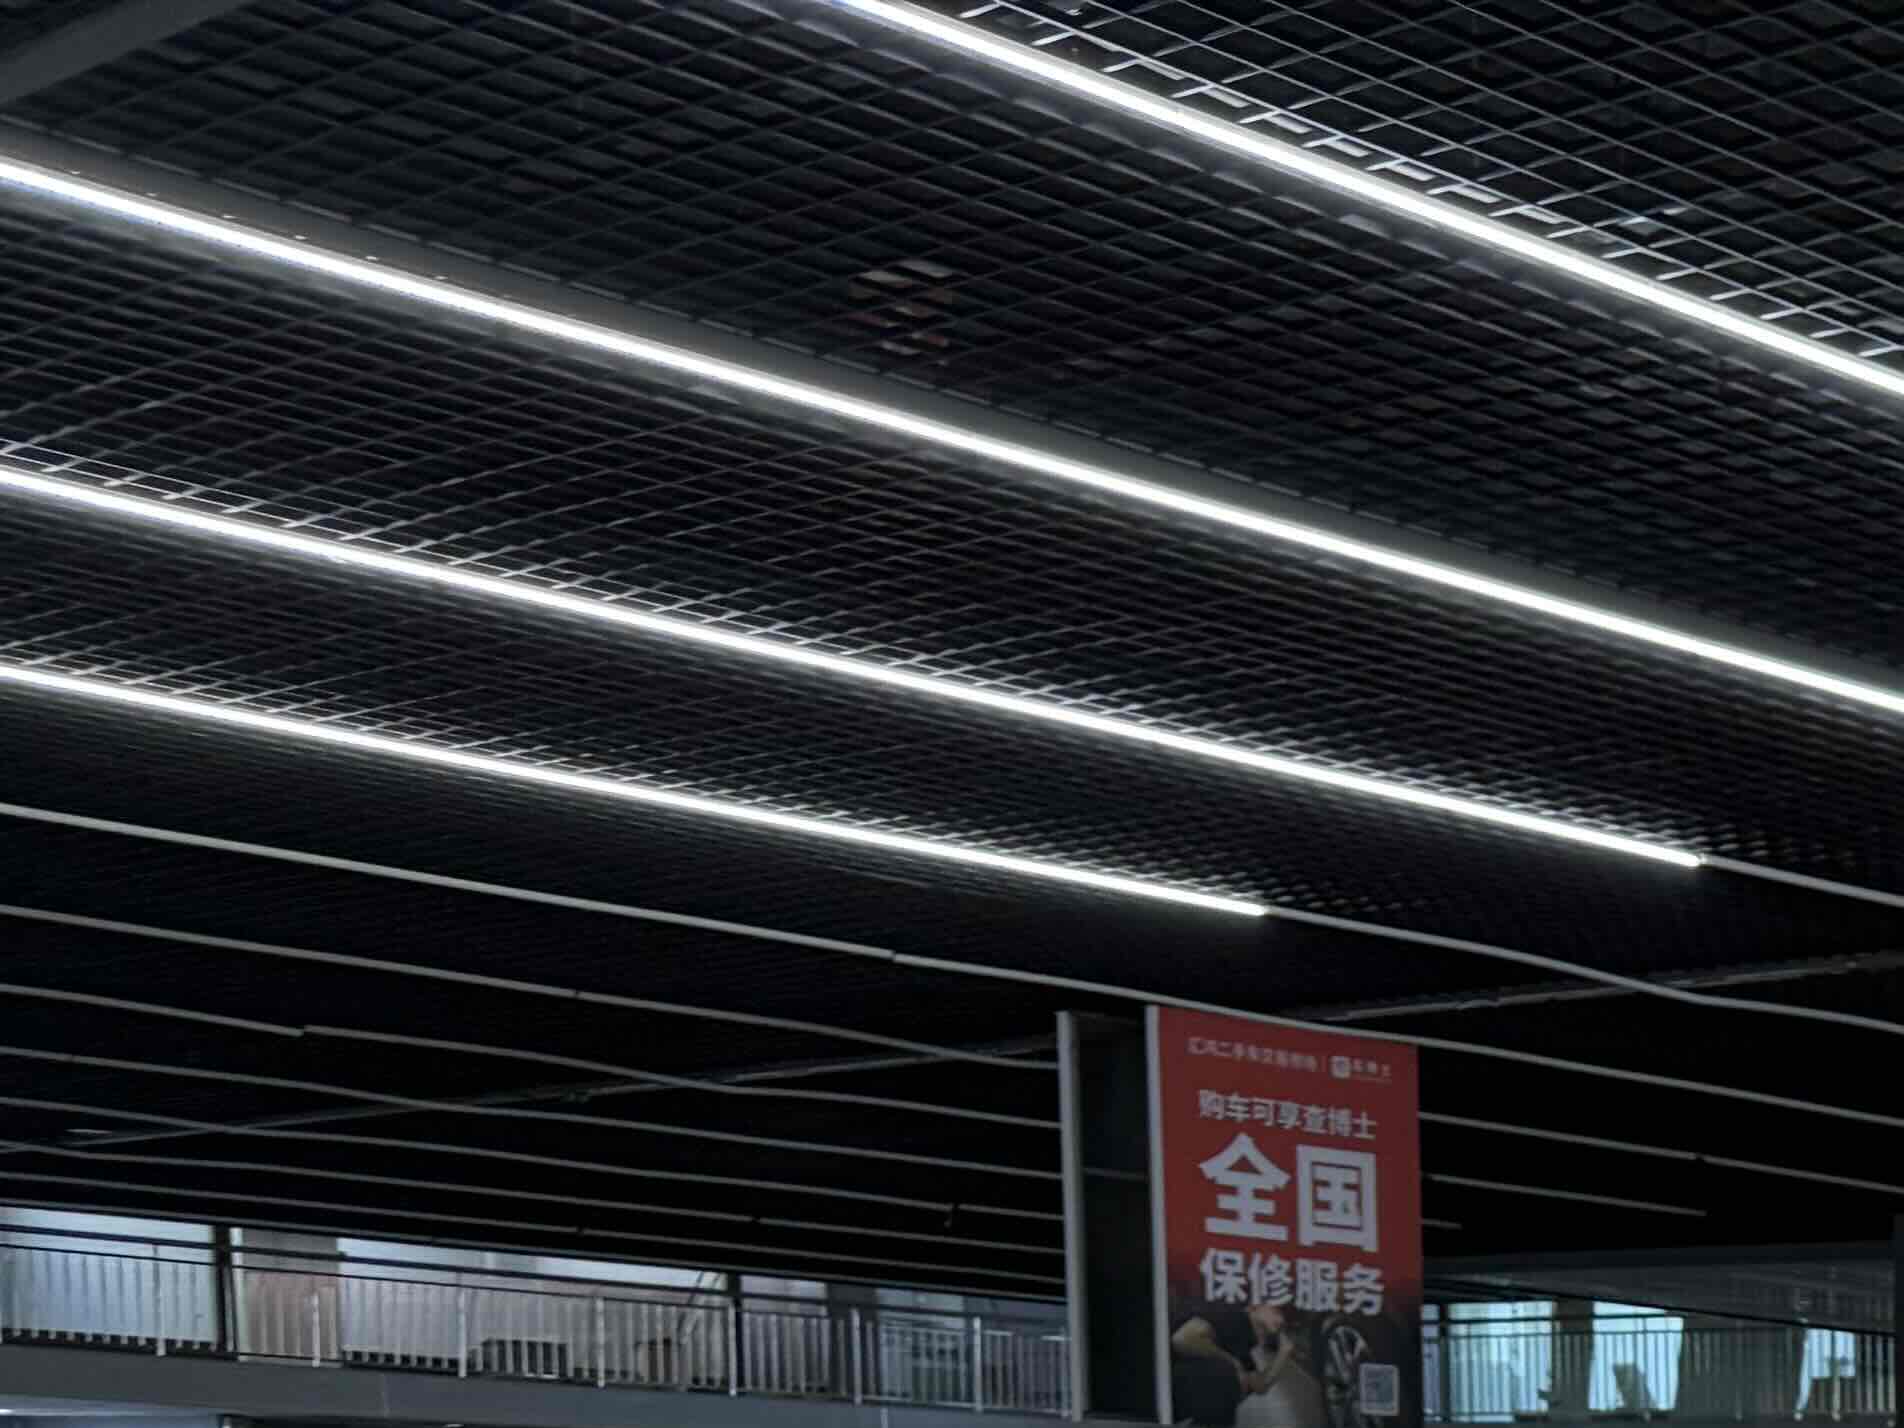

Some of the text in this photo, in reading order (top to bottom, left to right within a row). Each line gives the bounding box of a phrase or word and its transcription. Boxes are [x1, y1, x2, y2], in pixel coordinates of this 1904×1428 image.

[1198, 1131, 1379, 1253] 全国
[1199, 1247, 1385, 1317] 保修服务
